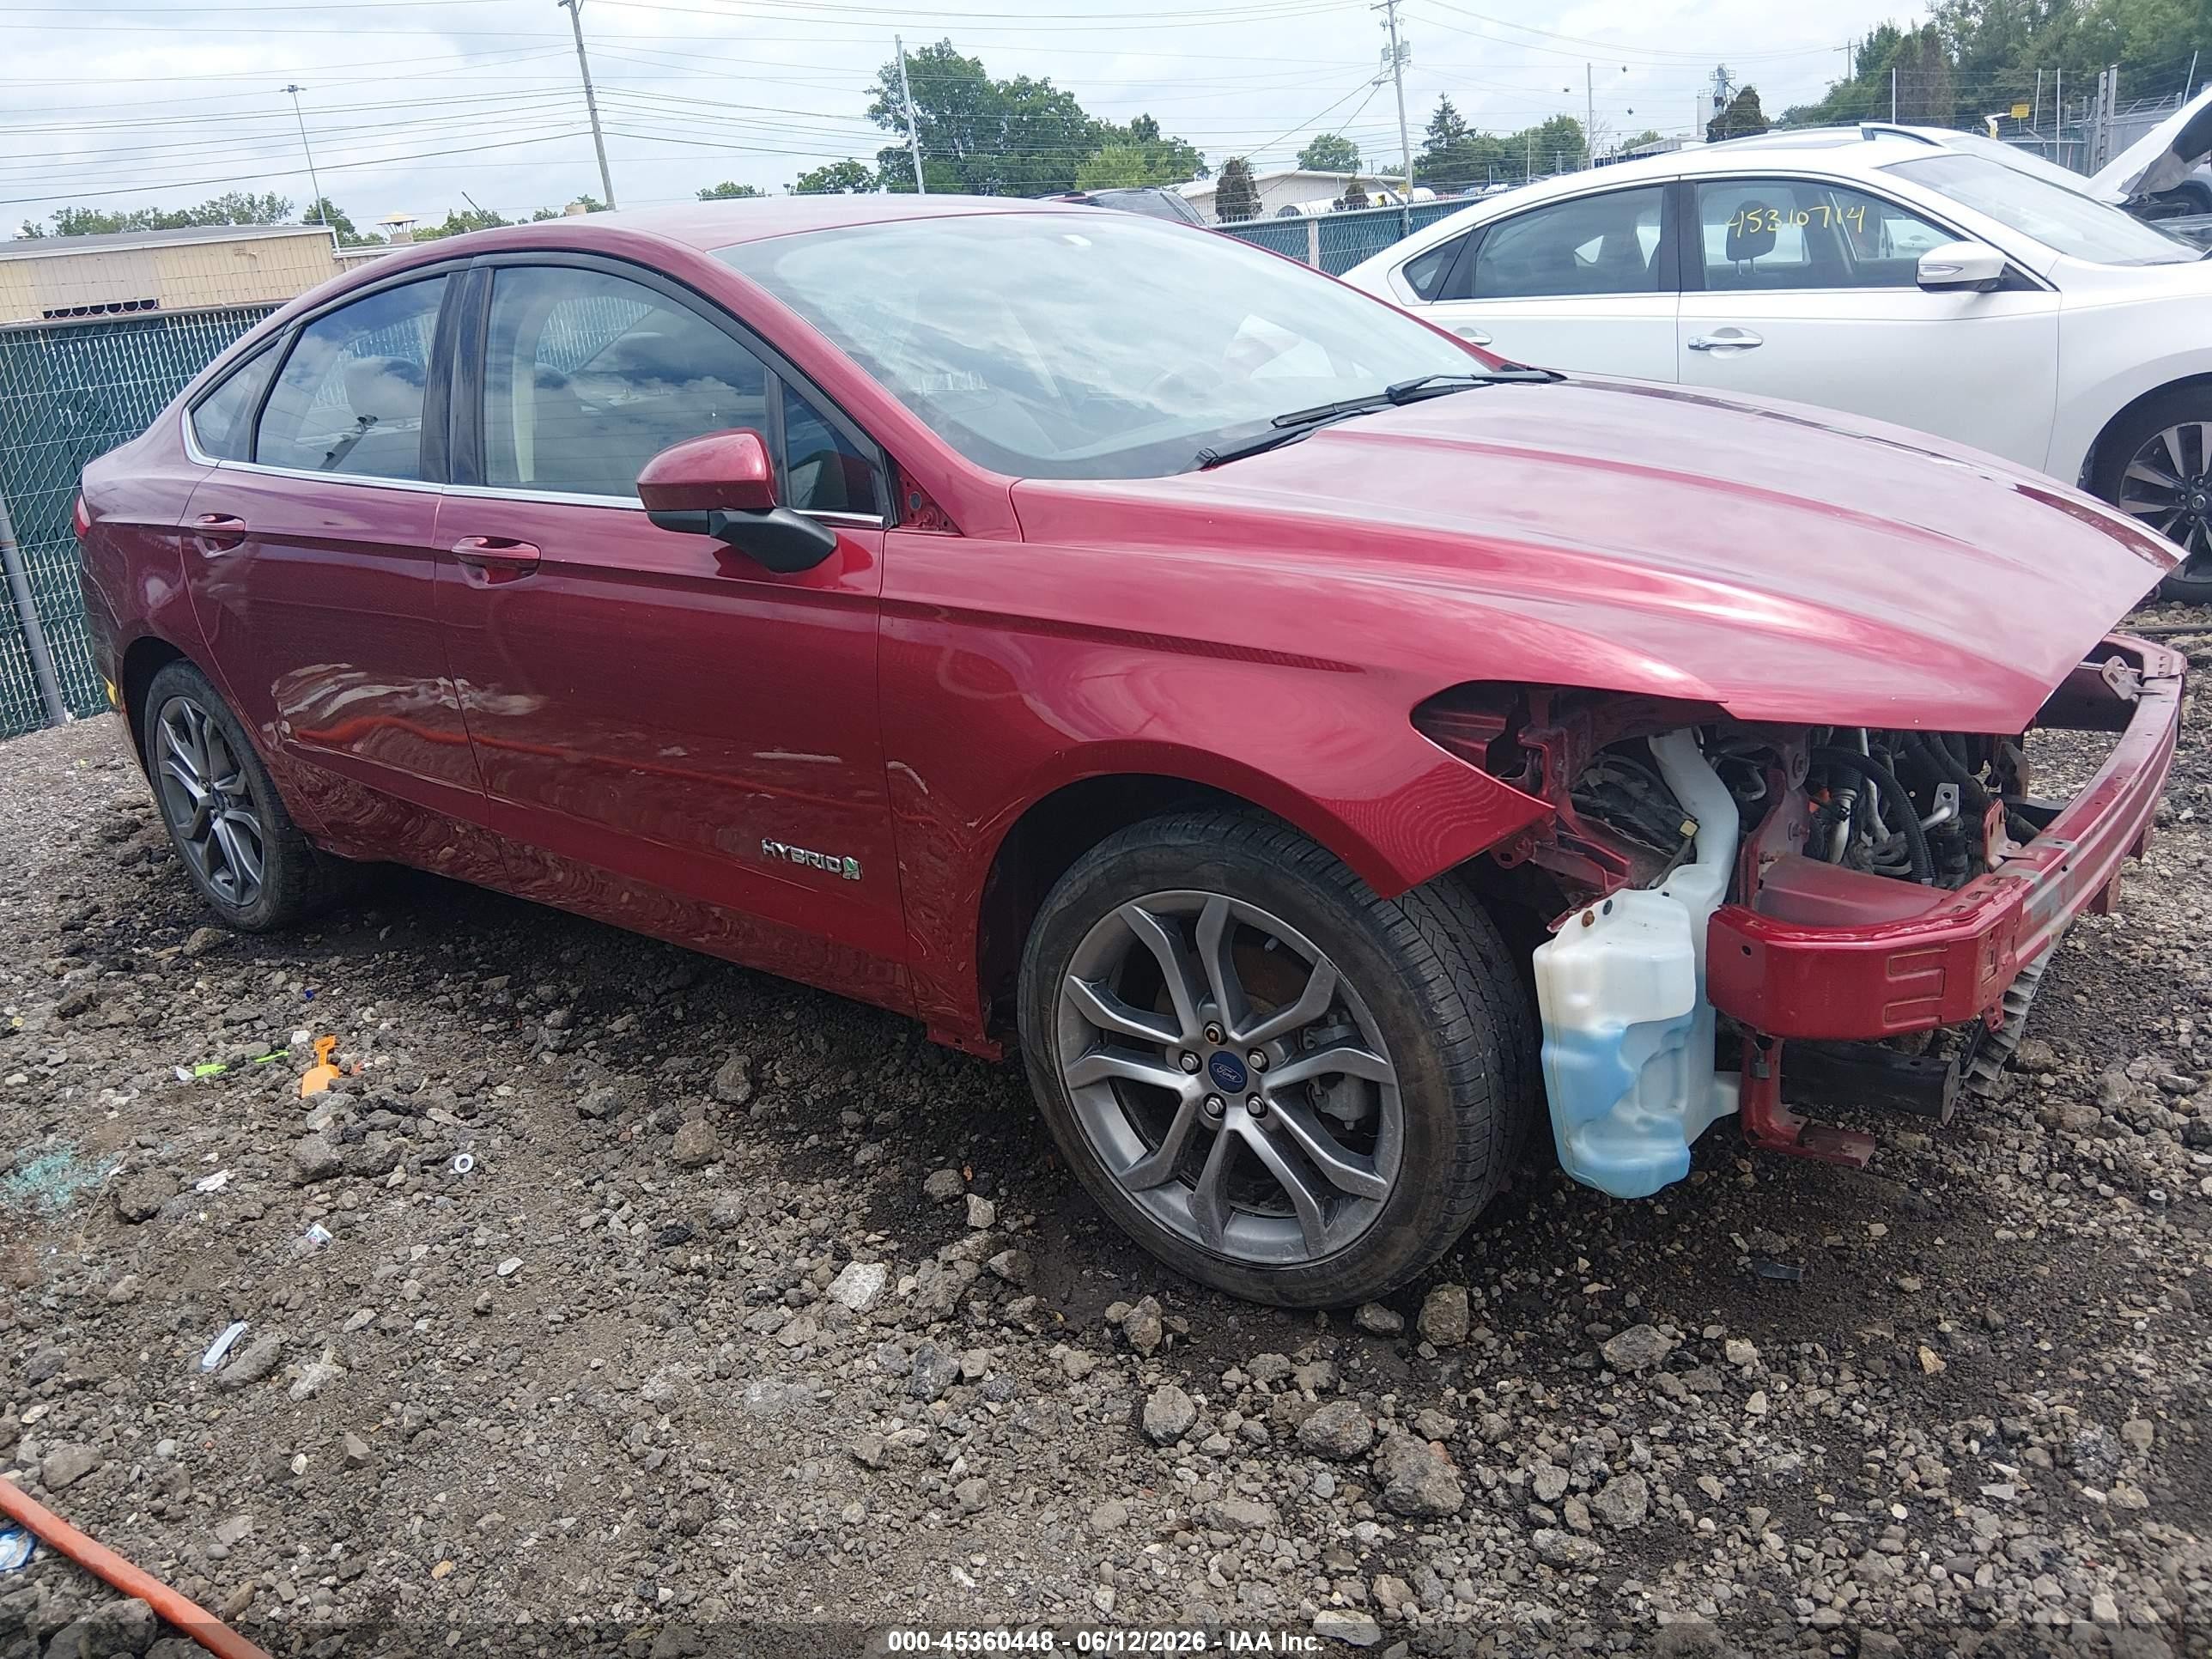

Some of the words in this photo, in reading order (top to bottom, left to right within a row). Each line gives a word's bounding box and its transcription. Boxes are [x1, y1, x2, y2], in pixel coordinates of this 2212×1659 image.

[1725, 205, 1865, 238] 45310714
[761, 838, 842, 873] HYBRID
[1216, 1065, 1237, 1081] Ford
